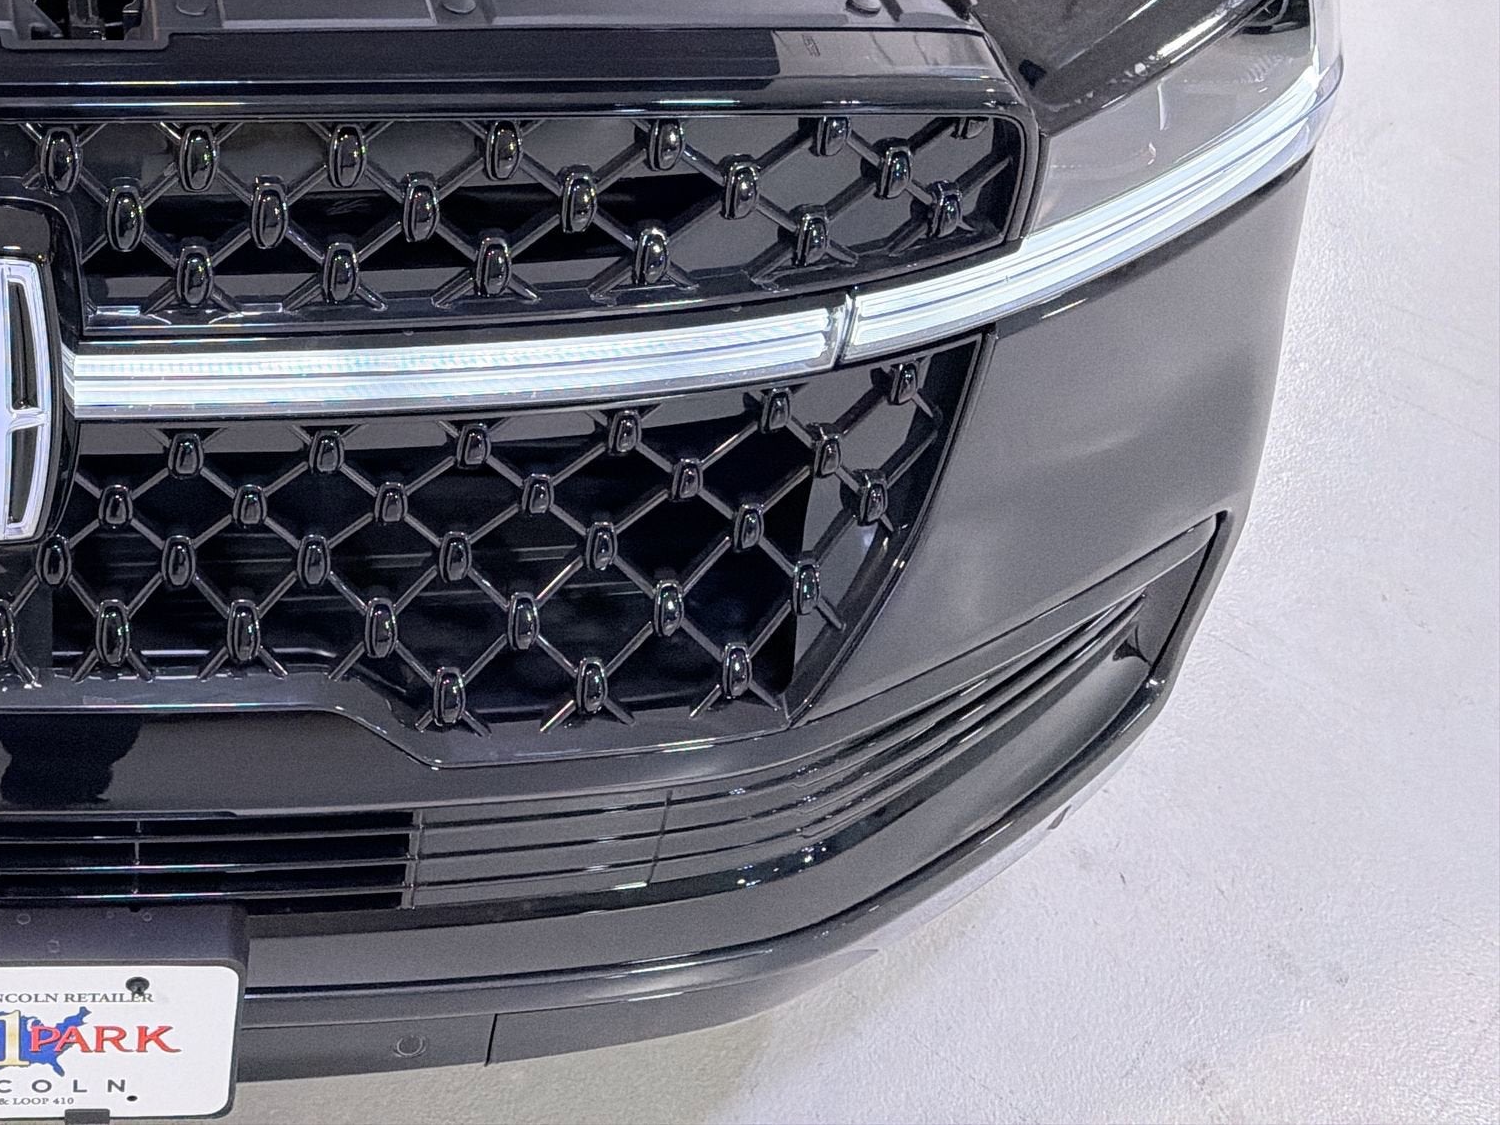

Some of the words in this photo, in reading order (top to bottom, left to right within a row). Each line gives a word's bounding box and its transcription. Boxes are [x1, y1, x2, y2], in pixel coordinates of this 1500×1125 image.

[63, 992, 155, 1003] RETAILER
[29, 1024, 182, 1053] PARK
[0, 1097, 10, 1106] &
[12, 1096, 49, 1106] LOOP
[52, 1096, 75, 1105] 410
